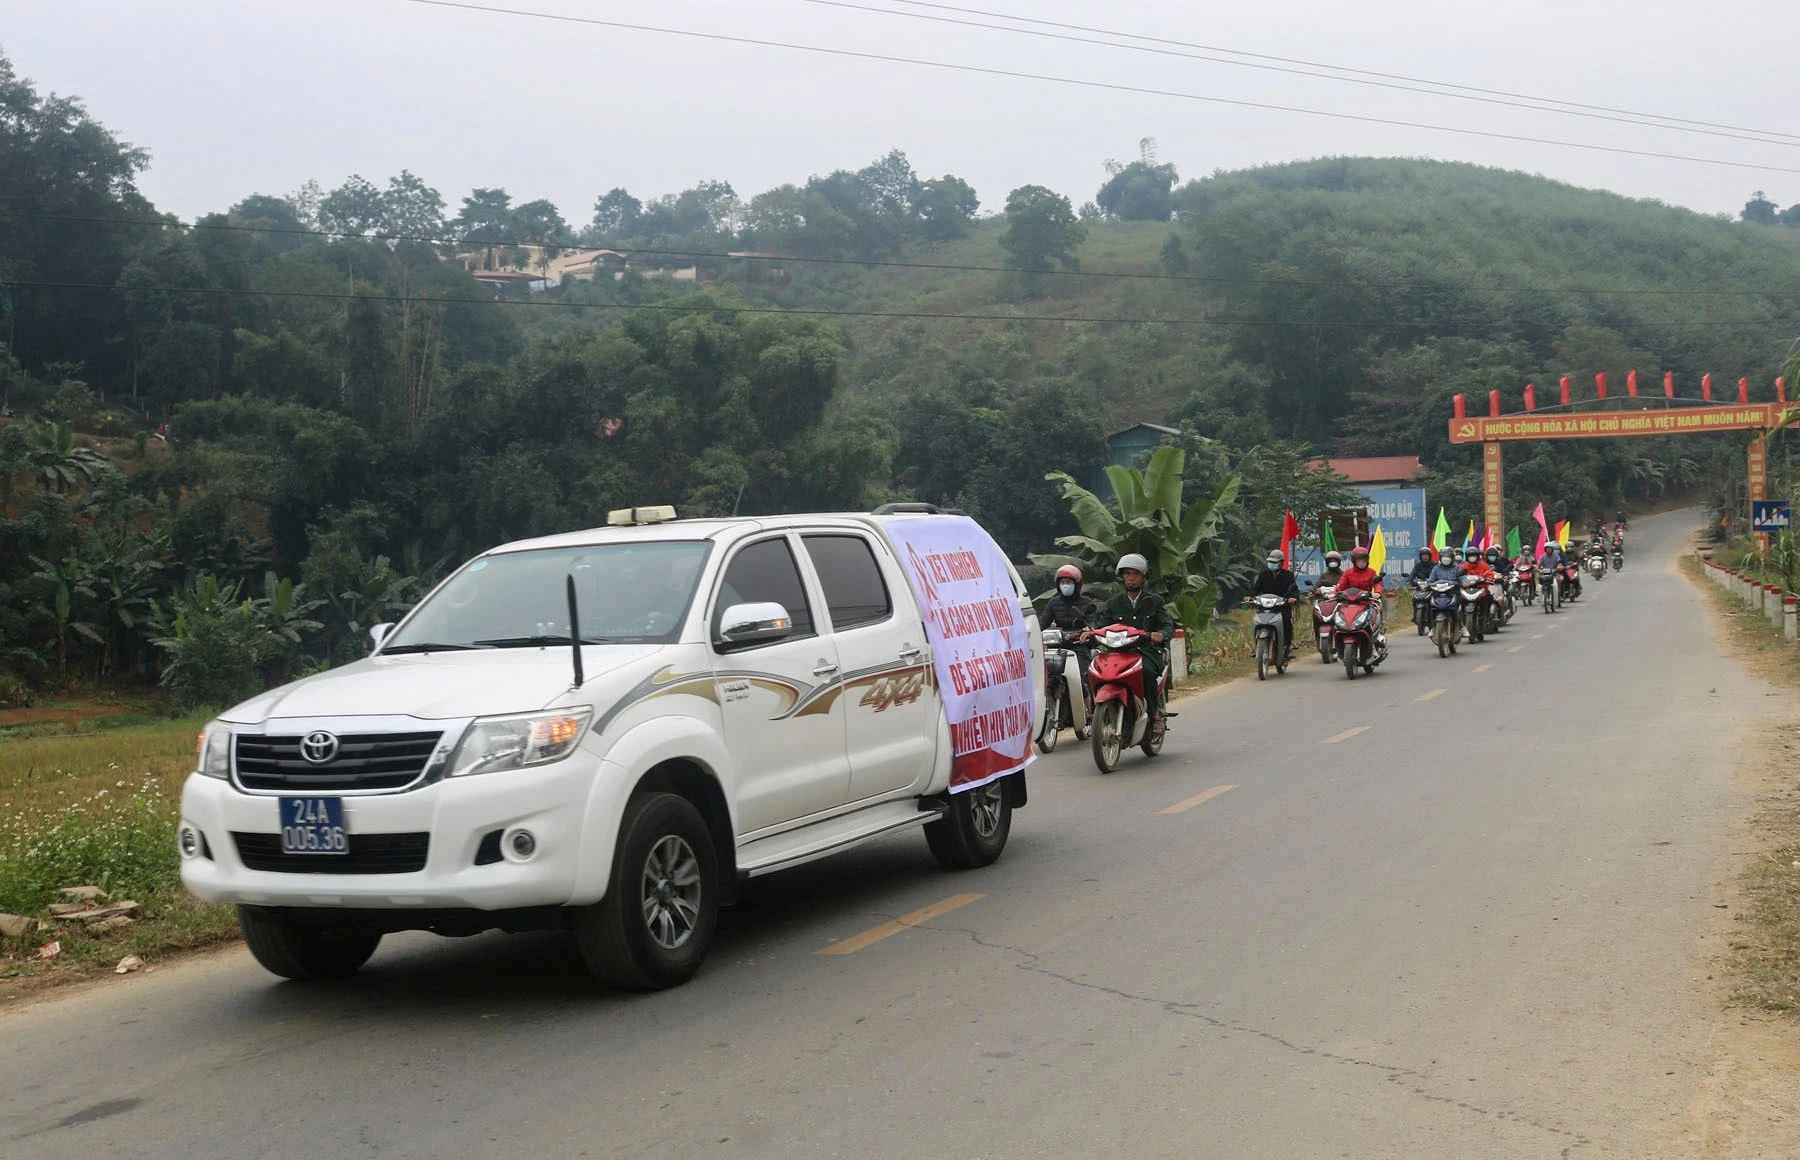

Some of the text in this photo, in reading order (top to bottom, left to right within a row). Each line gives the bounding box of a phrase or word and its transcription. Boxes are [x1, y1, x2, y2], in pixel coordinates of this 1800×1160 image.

[1486, 410, 1764, 436] NƯỚC CỘNG HÒA XÃ HỘI CHỦ NGHĨA VIỆT NAM MUÔN NĂM!
[1381, 503, 1396, 520] LẠC
[1395, 529, 1410, 548] CỰC
[943, 546, 984, 586] NGHIỆM
[948, 599, 979, 638] CÁCH
[971, 602, 995, 632] DUY
[965, 648, 991, 692] BIẾT
[985, 649, 1009, 686] TÌNH
[989, 709, 1006, 744] HIV
[292, 799, 330, 824] 24A
[283, 826, 346, 850] 005.36
